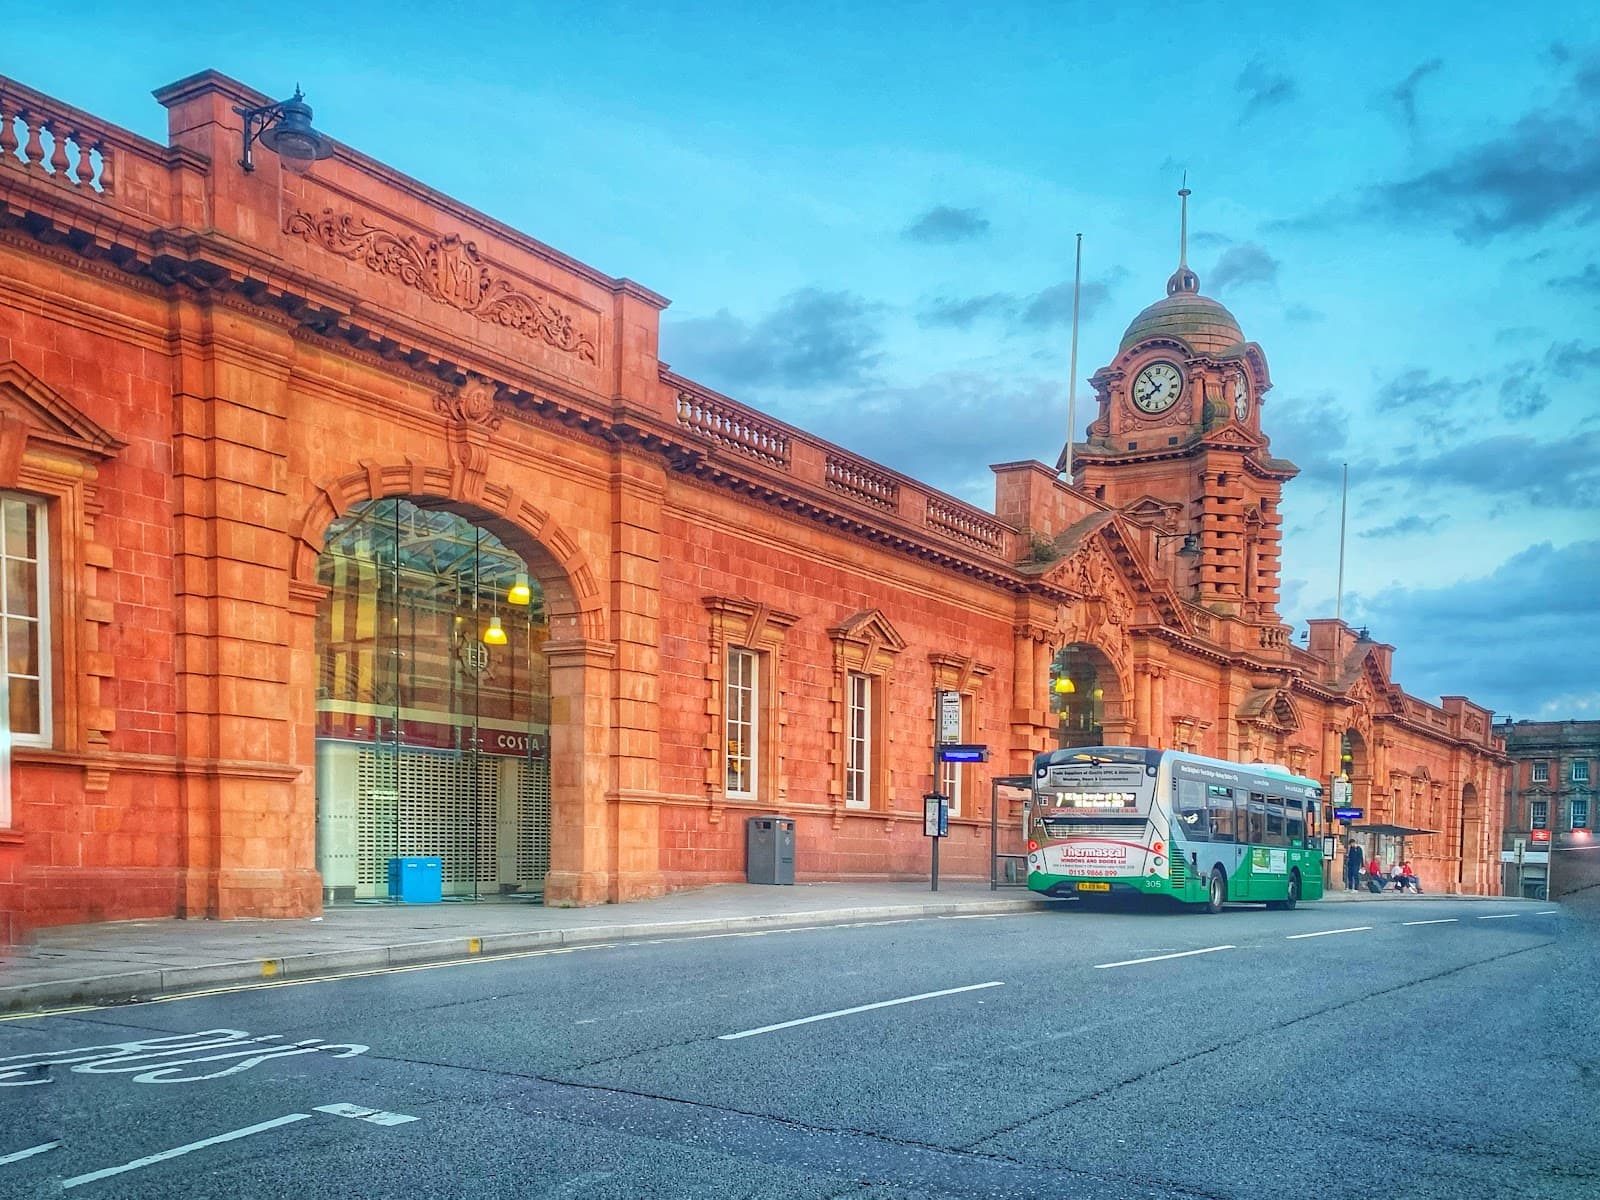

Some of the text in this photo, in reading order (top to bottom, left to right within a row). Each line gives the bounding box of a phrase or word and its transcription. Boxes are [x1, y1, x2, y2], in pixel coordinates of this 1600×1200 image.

[497, 734, 540, 751] COSTA
[1062, 846, 1127, 858] Thermaseal
[1145, 880, 1161, 888] 305
